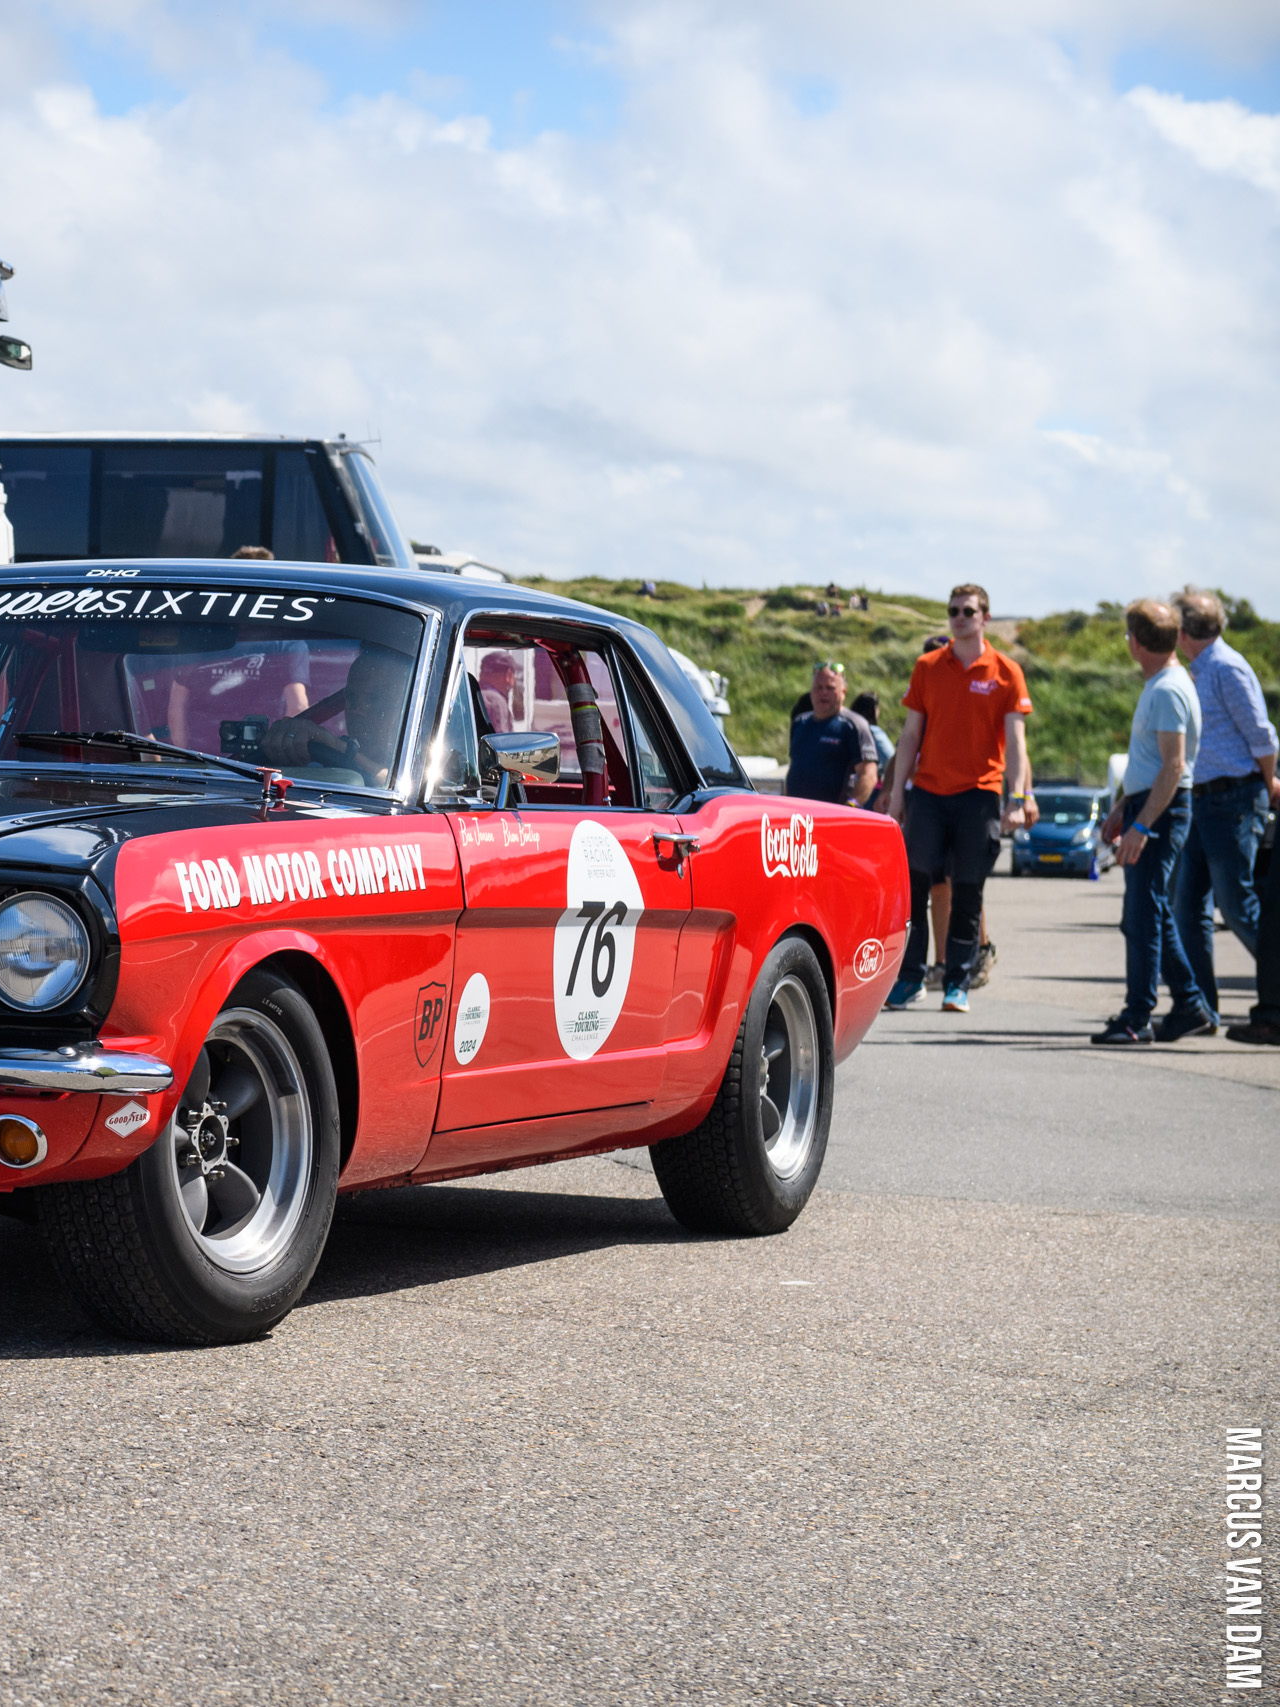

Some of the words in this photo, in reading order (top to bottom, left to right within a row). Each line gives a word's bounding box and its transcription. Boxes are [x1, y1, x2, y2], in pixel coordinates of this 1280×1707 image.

[86, 569, 140, 577] DHG
[584, 848, 614, 862] RACING
[761, 813, 818, 878] Coca-Cola
[175, 858, 241, 913] FORD
[242, 850, 327, 906] MOTOR
[327, 843, 426, 897] COMPANY
[565, 900, 628, 998] 76
[859, 945, 880, 974] Ford
[418, 998, 443, 1041] BP
[574, 1020, 600, 1033] TOURING
[578, 1010, 600, 1021] CLASSIC
[459, 1039, 477, 1054] 2024
